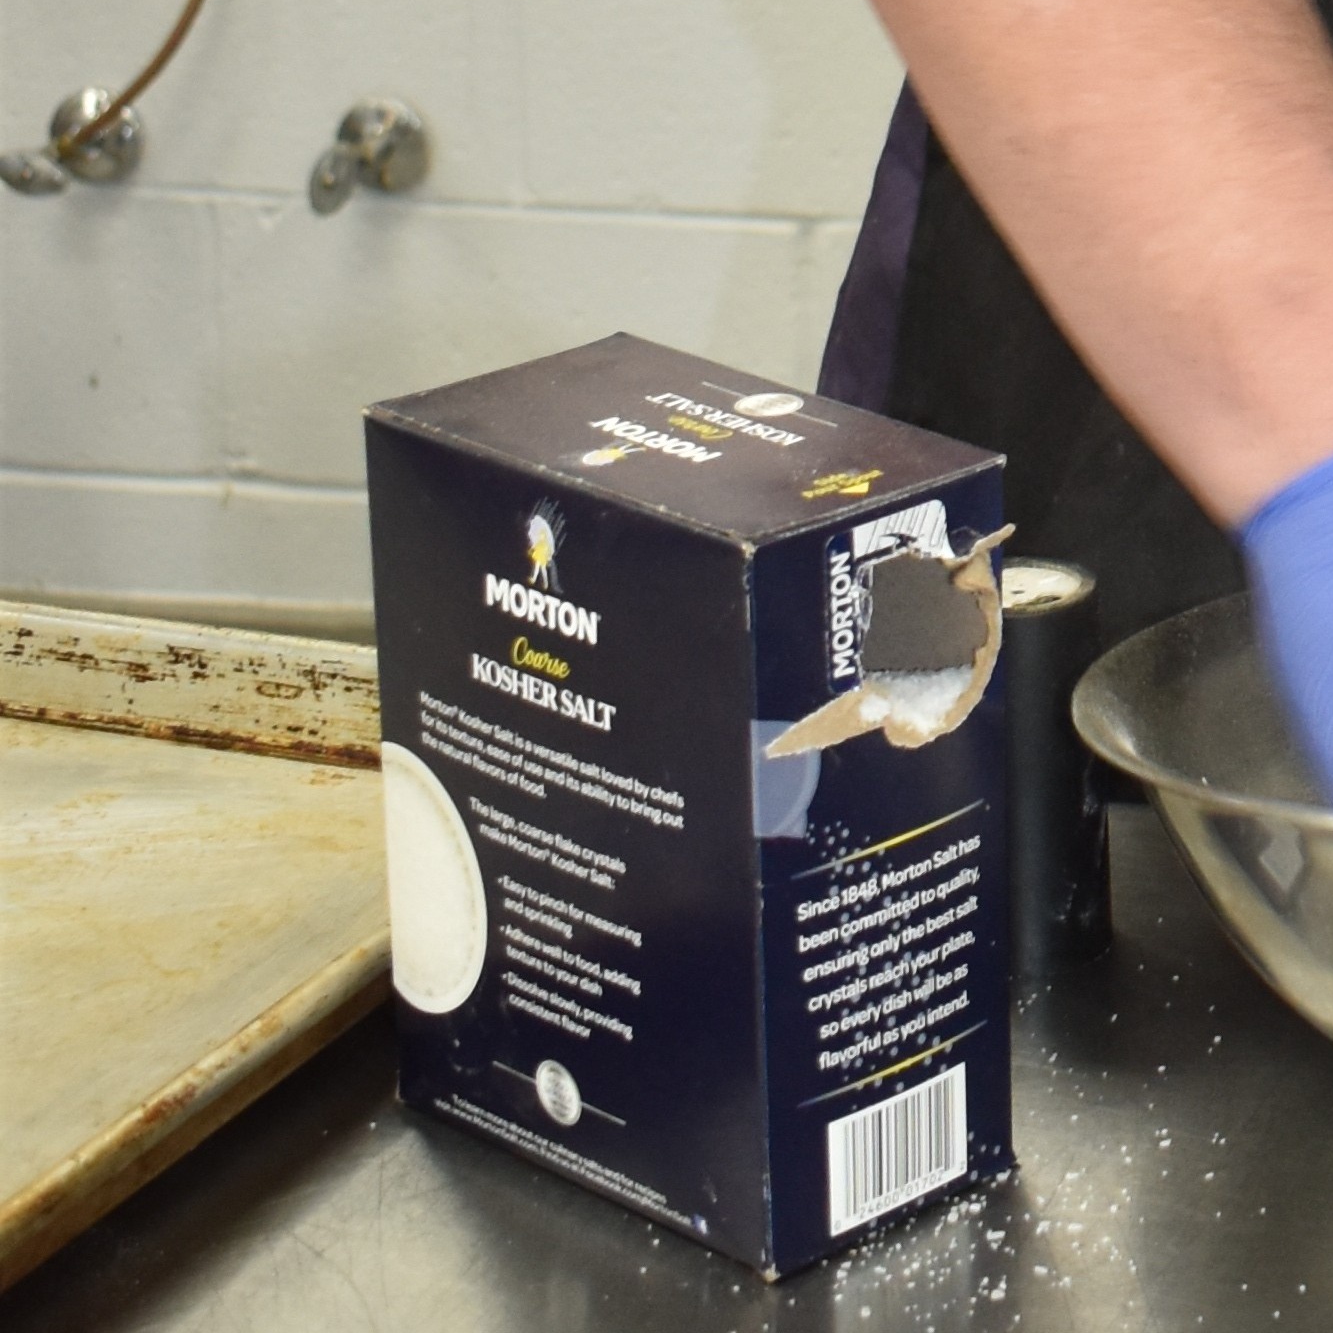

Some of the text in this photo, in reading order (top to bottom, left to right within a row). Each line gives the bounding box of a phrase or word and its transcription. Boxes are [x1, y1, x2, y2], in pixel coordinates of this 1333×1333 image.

[590, 416, 723, 463] MORTON
[485, 573, 599, 646] MORTON
[831, 551, 855, 678] MORTON
[472, 653, 617, 732] KOSHER SALT
[511, 636, 572, 679] Coarse
[797, 834, 981, 922] Since 1848, Morton Salt has
[798, 865, 981, 953] been committed to quality,
[803, 895, 979, 984] ensuring only the best salt
[808, 931, 976, 1013] crystals reach your plate,
[818, 989, 970, 1070] flavorful as you intend.
[820, 963, 969, 1039] so every dish will be as
